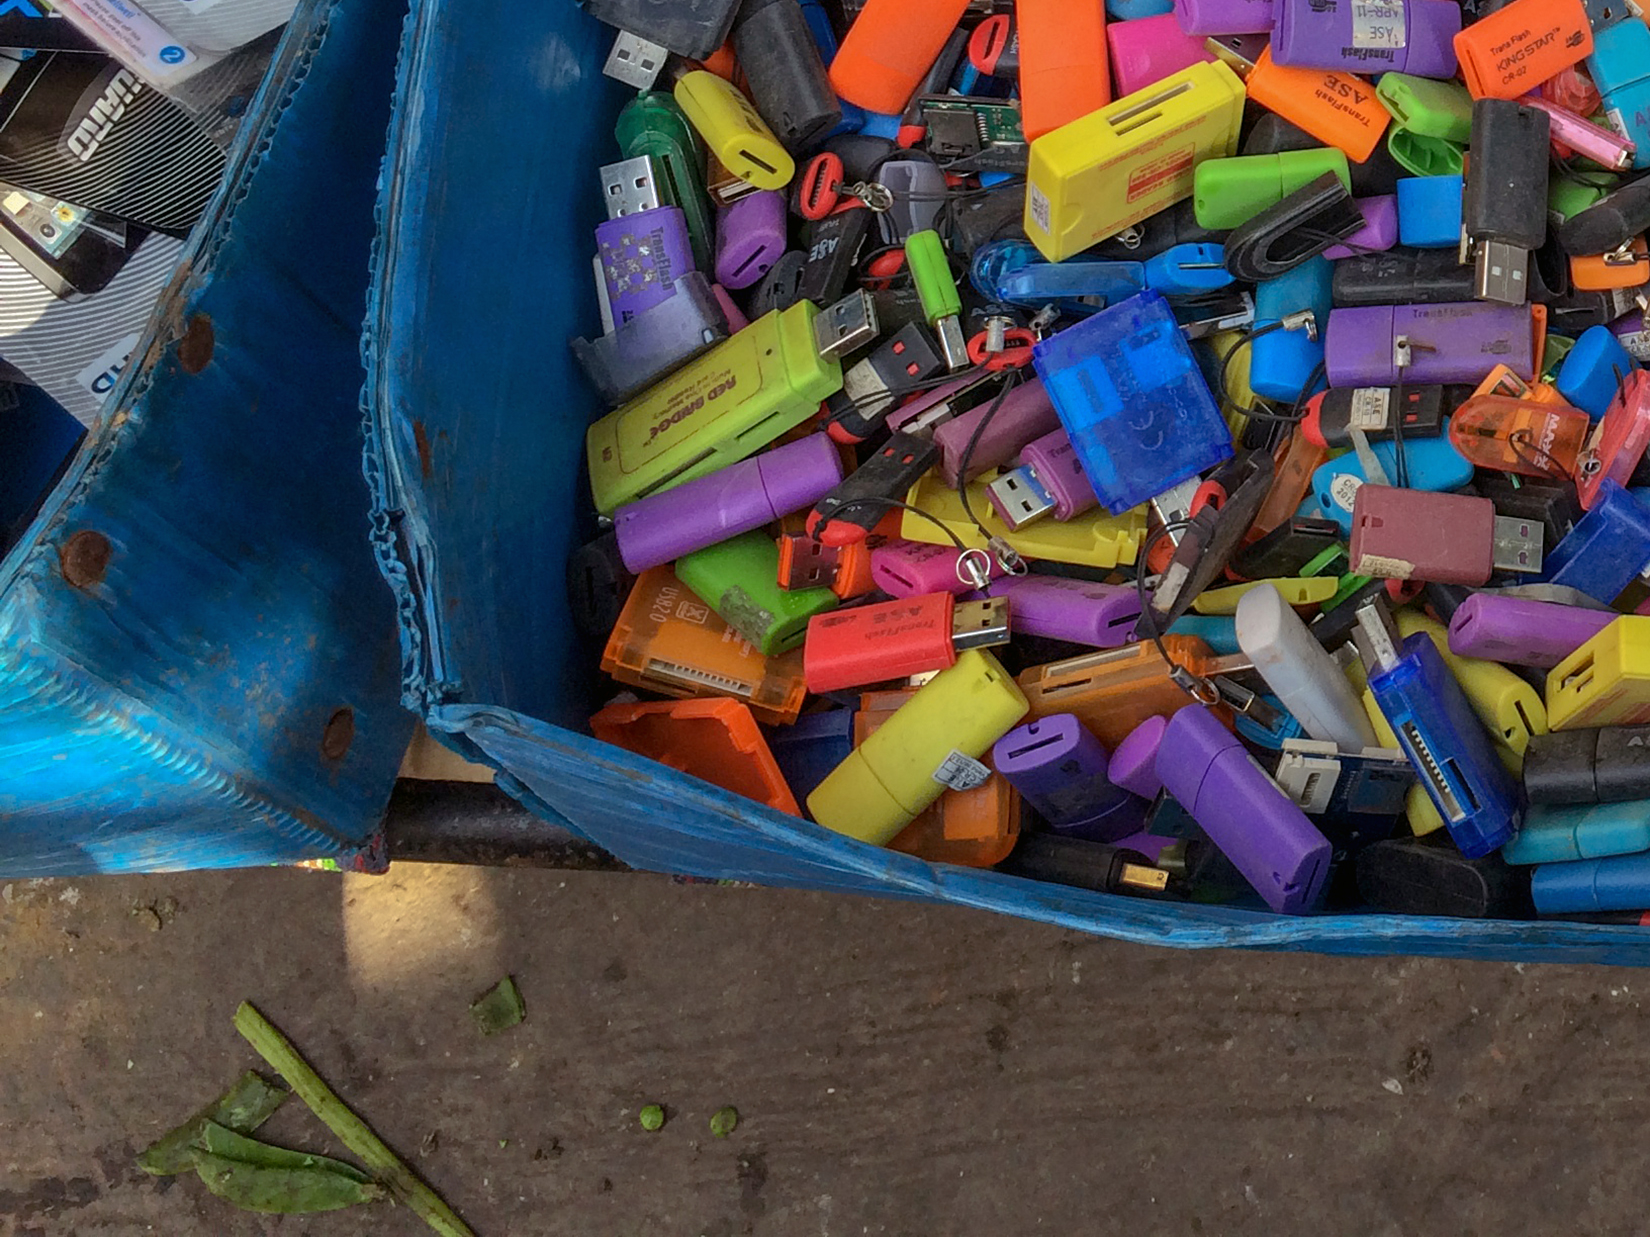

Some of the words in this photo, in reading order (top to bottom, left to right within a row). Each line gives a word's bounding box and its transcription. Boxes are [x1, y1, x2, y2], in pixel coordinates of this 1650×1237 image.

[1367, 24, 1393, 40] ASE
[1488, 37, 1514, 58] Trans
[1510, 27, 1533, 46] Flash
[1341, 46, 1395, 62] TransFlash
[1320, 72, 1373, 107] ASE
[1499, 63, 1529, 86] CR-02
[63, 68, 146, 162] UARD
[1311, 88, 1372, 129] TransFlash
[651, 226, 674, 292] TransFlash
[806, 233, 843, 262] ASE
[700, 373, 740, 407] RED
[645, 394, 709, 441] BRIDGE
[644, 583, 682, 627] USB2.0
